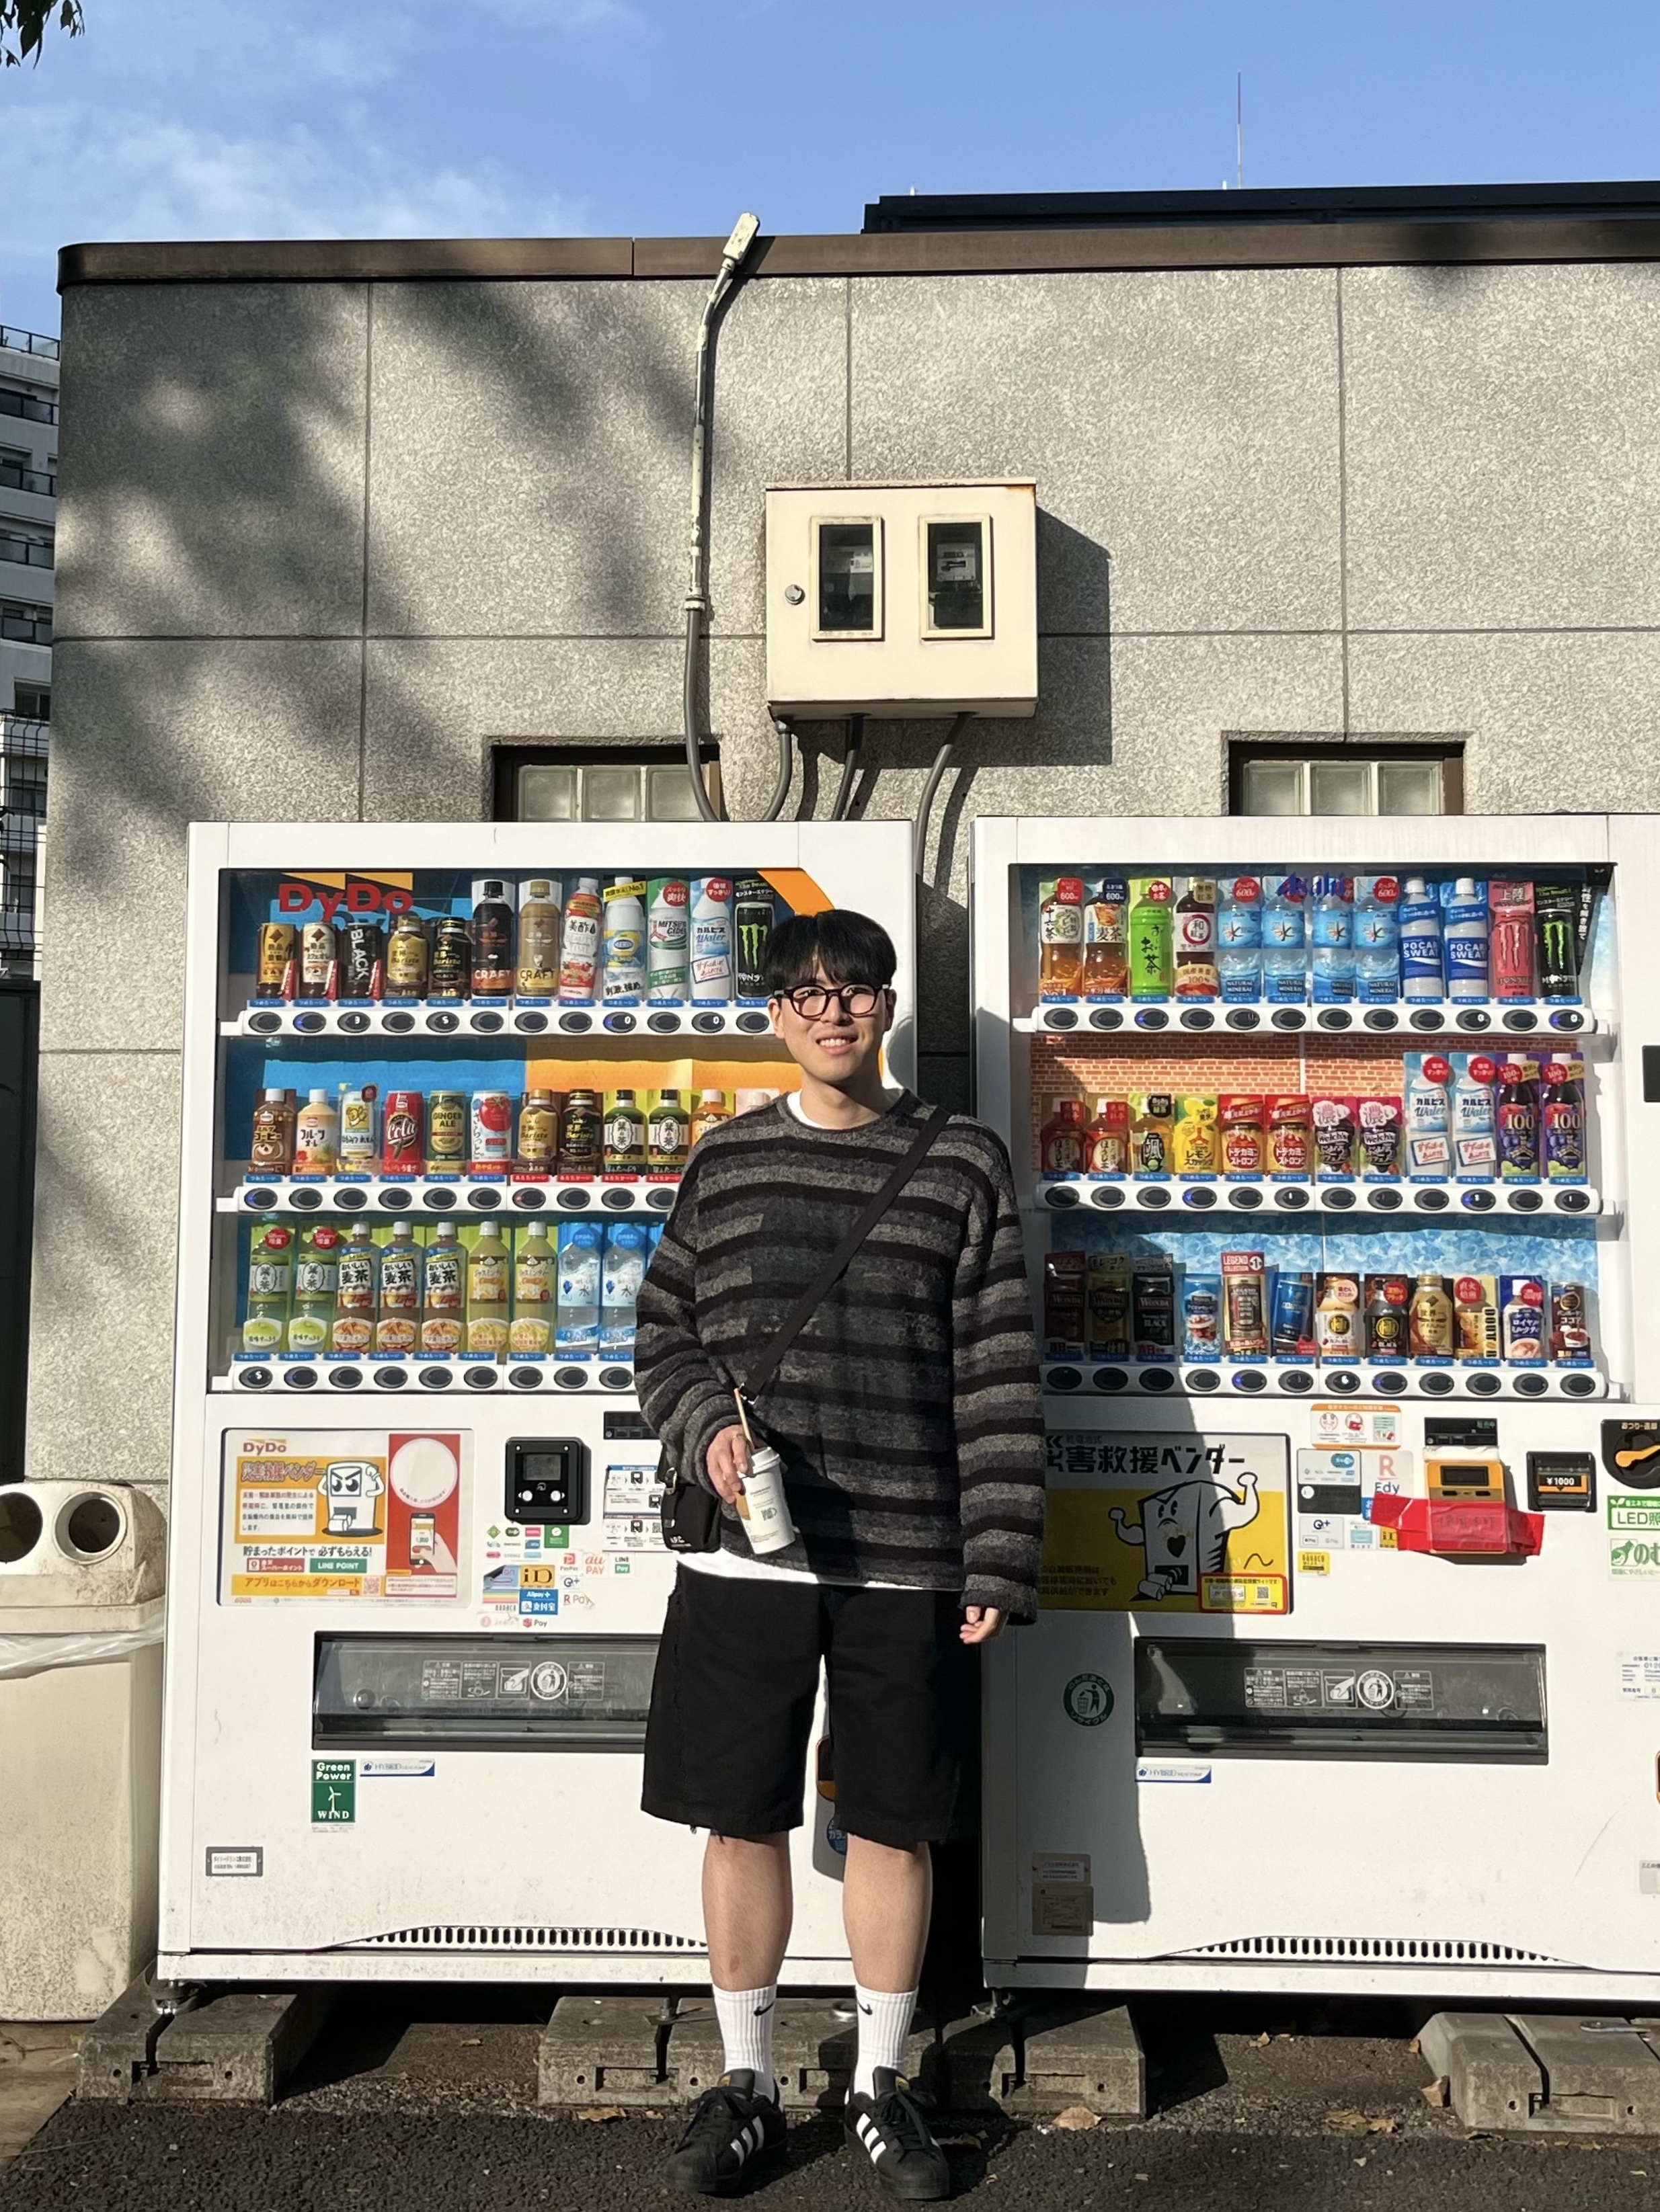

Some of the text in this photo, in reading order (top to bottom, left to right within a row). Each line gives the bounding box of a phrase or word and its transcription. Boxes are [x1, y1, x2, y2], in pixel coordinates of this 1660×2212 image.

[278, 883, 414, 923] DyDo
[1044, 907, 1058, 942] 十六茶
[1097, 926, 1123, 942] 麦茶
[350, 928, 369, 981] BLACK
[474, 969, 511, 979] CRAFT
[520, 969, 555, 981] CRAFT
[1416, 1098, 1445, 1106] カルピス
[1462, 1098, 1491, 1106] カルピス
[432, 1112, 463, 1120] GINGER
[1415, 1106, 1445, 1116] Water
[1460, 1106, 1491, 1116] Water
[1507, 1114, 1535, 1130] 100
[1552, 1113, 1581, 1129] 100
[388, 1118, 416, 1139] Cola
[1186, 1150, 1212, 1158] レモン
[341, 1262, 369, 1271] おいしい
[384, 1262, 412, 1272] おいしい
[428, 1262, 457, 1272] おいしい
[341, 1270, 369, 1284] 麦茶
[384, 1270, 413, 1285] 麦茶
[429, 1270, 457, 1285] 麦茶
[1140, 1297, 1170, 1307] WONDA
[243, 1442, 287, 1456] DyDo
[1374, 1481, 1400, 1496] Edy
[586, 1566, 605, 1575] PAY
[316, 1762, 351, 1772] Green
[315, 1771, 352, 1780] Power
[317, 1810, 350, 1820] WIND
